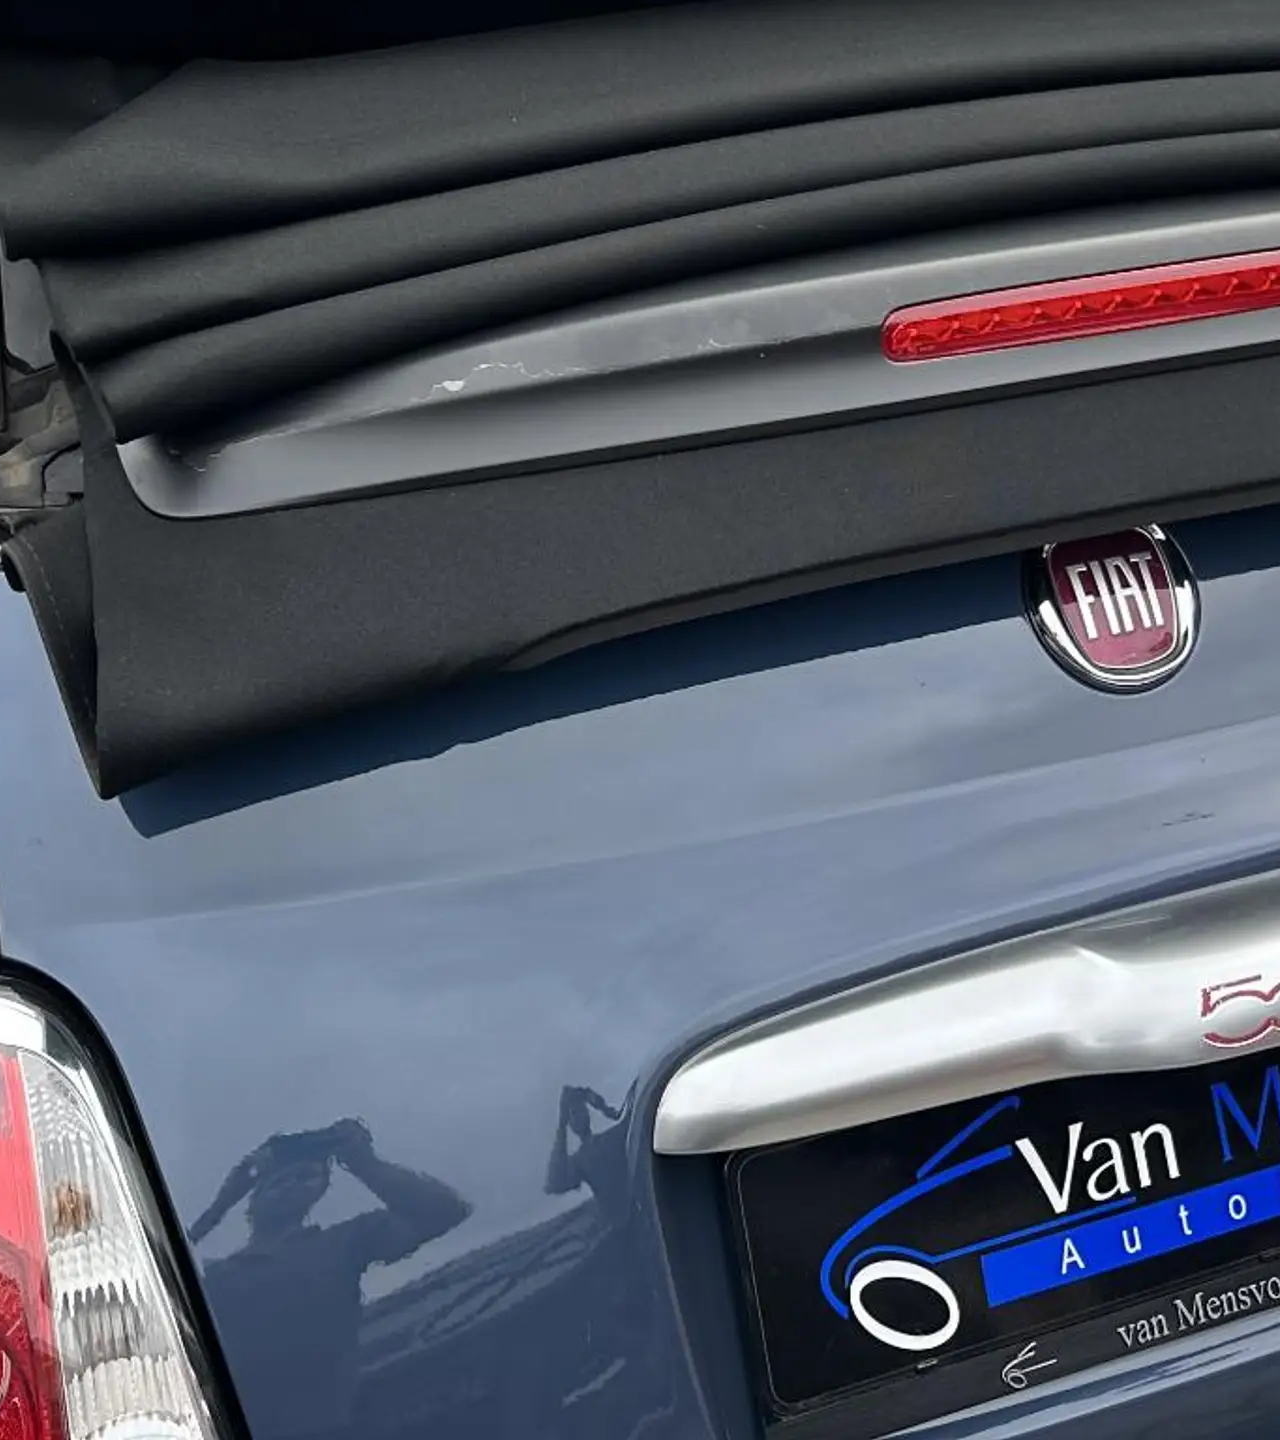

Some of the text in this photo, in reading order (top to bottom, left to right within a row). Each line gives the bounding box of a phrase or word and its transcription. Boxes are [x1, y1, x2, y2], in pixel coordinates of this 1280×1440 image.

[1065, 551, 1165, 641] FIAT
[1014, 1115, 1181, 1216] Van
[1117, 1311, 1170, 1350] van
